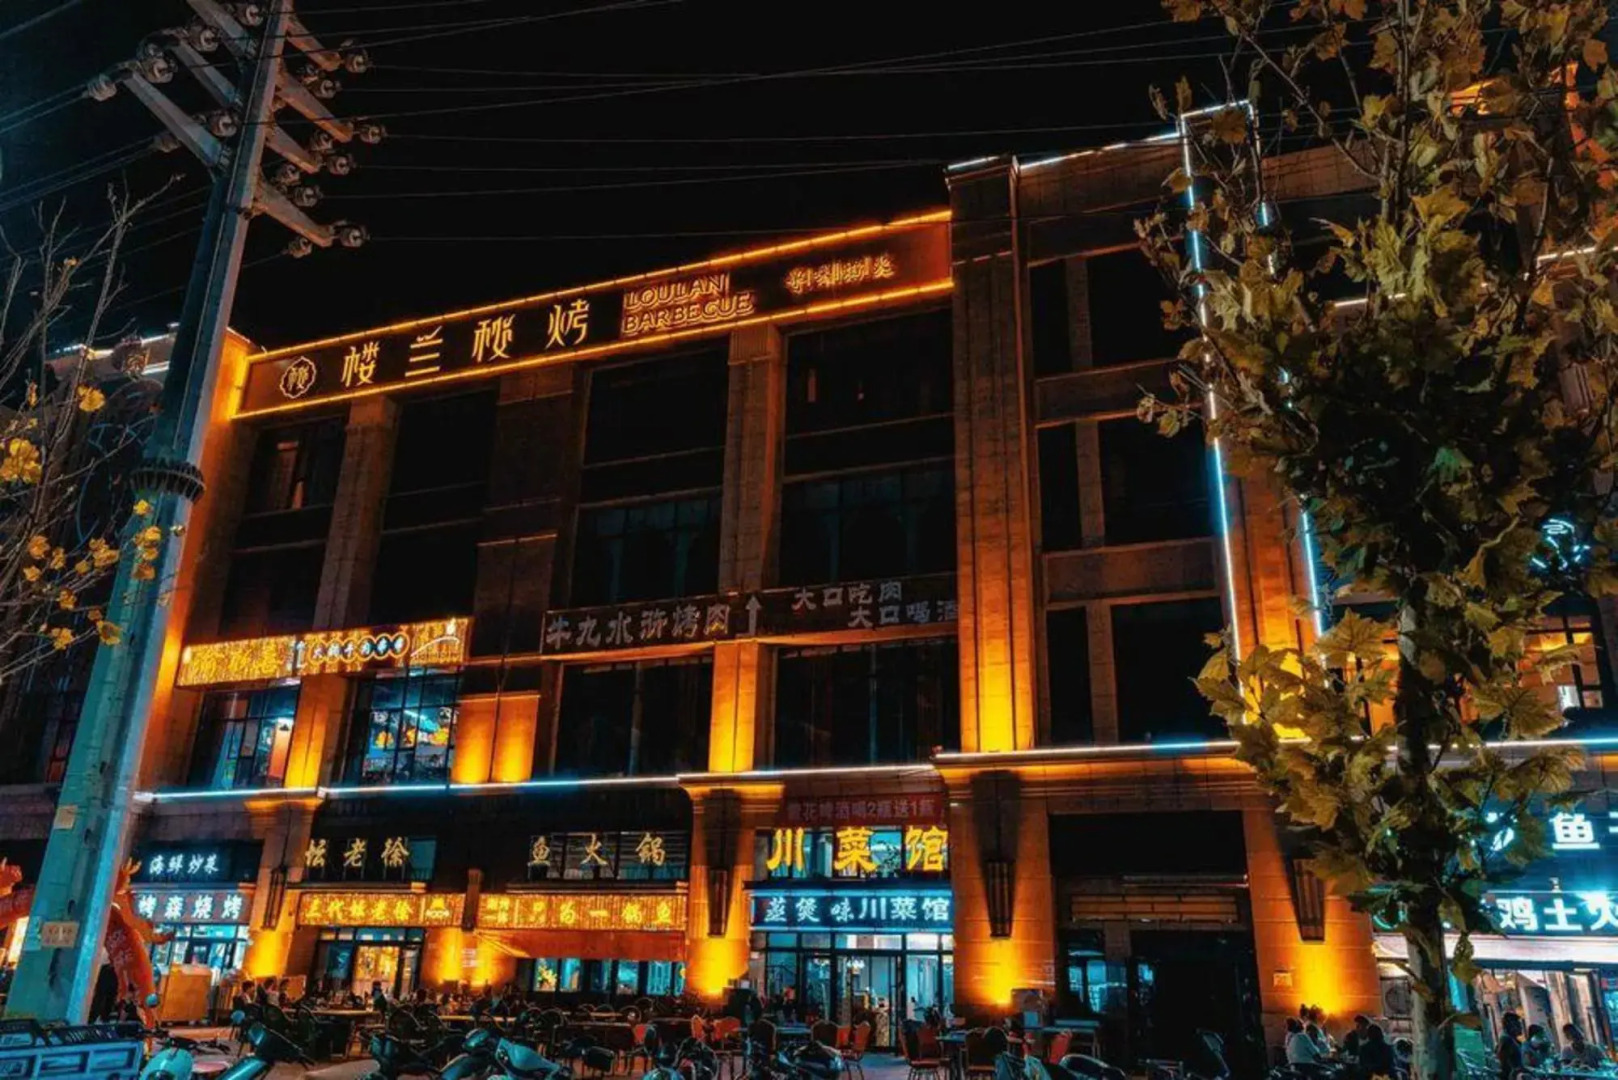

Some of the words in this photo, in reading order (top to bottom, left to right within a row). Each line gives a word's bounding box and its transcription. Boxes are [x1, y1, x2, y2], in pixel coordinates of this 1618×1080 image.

[620, 291, 755, 337] BARBECUE
[622, 272, 731, 312] LOULAN
[340, 299, 592, 388] 楼兰秘烤
[791, 580, 902, 612] 大口吃肉
[766, 825, 949, 873] 川菜馆
